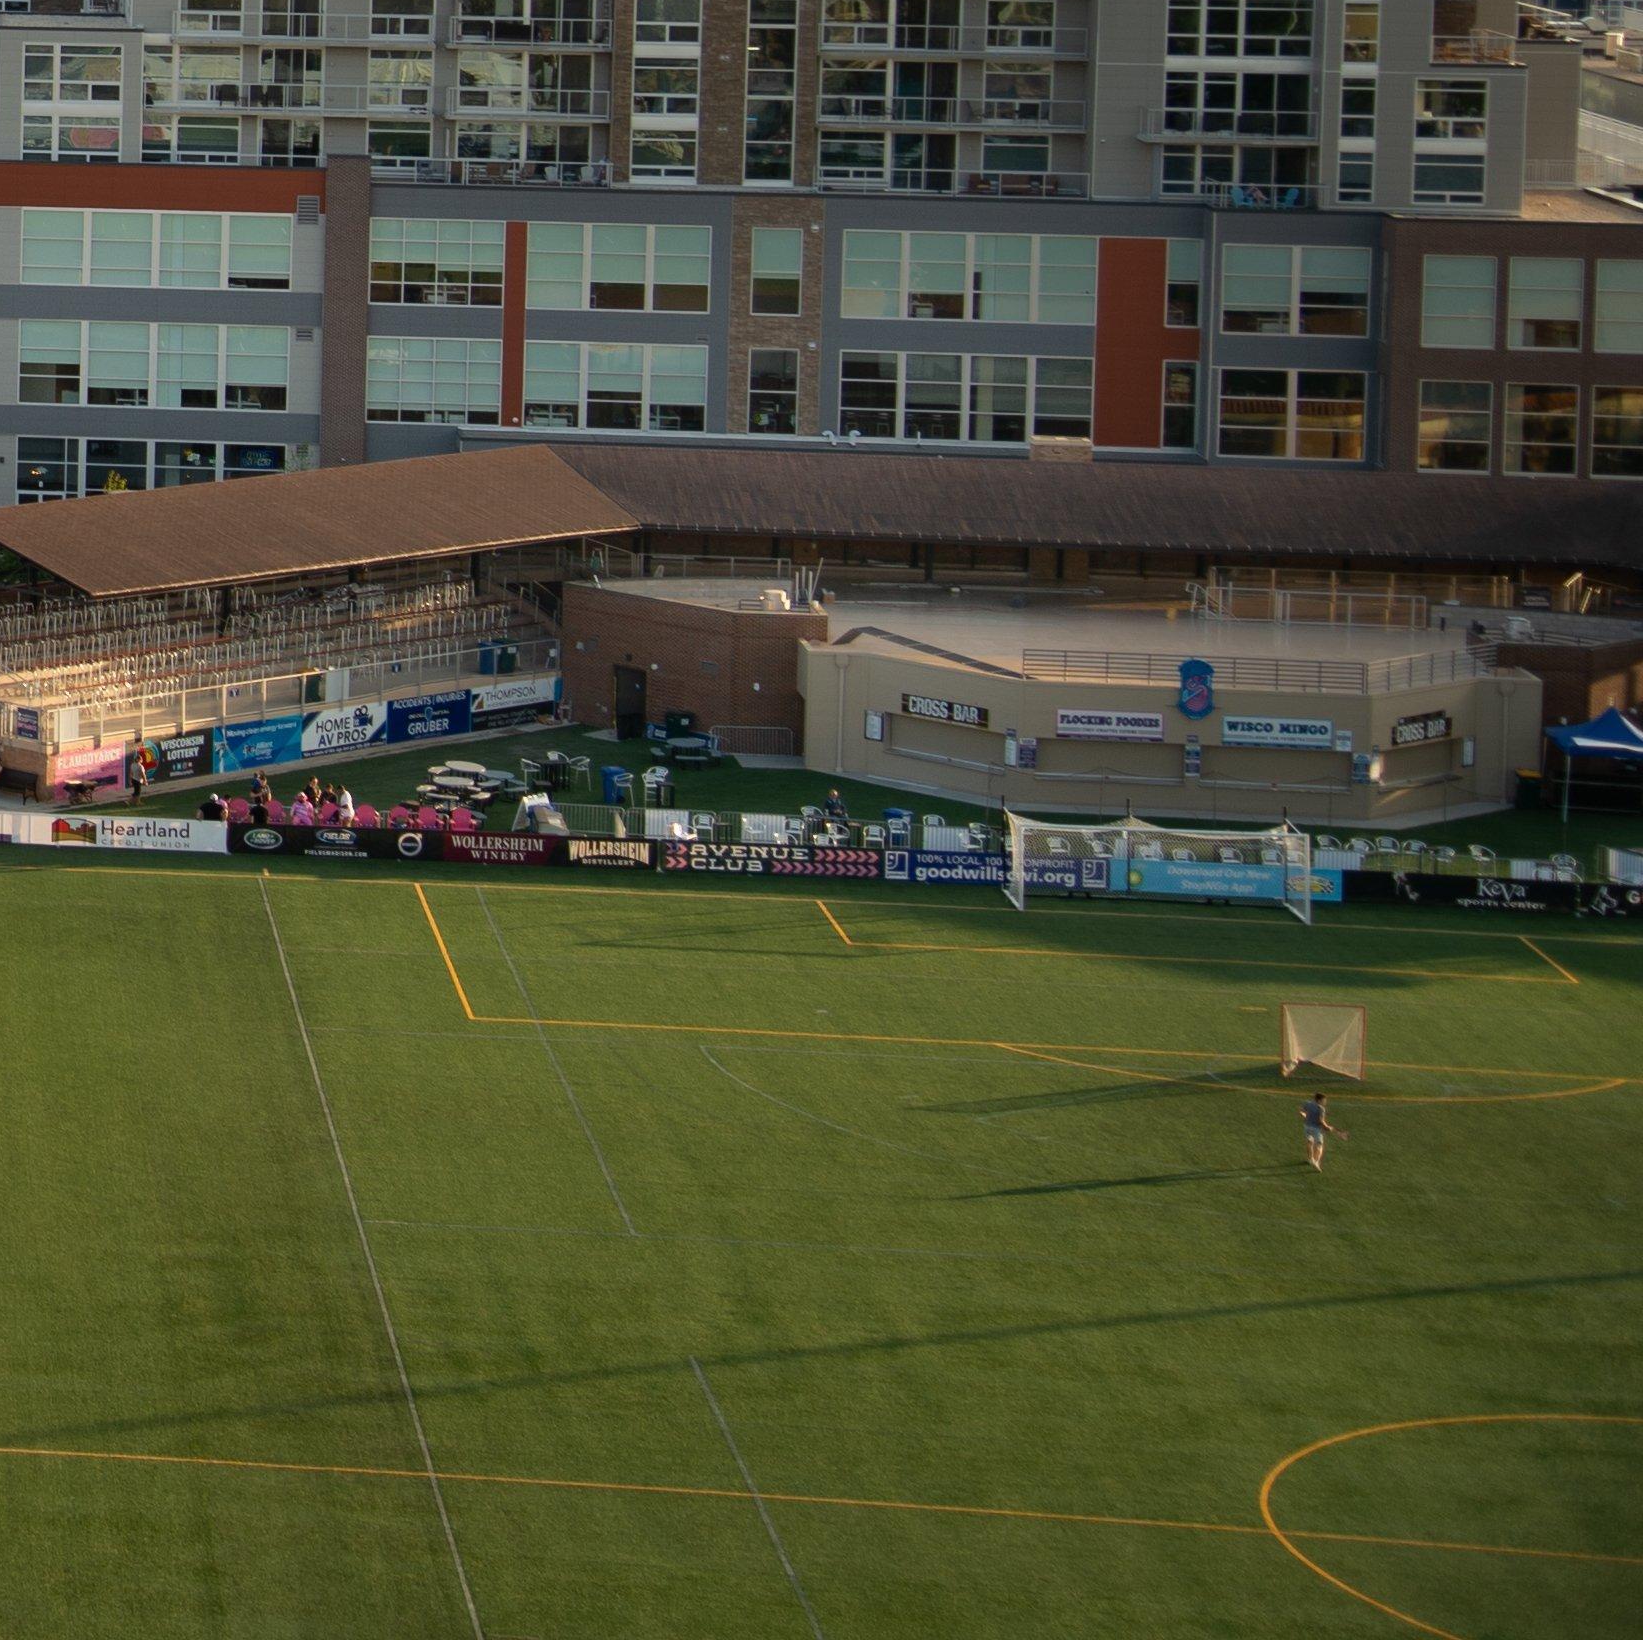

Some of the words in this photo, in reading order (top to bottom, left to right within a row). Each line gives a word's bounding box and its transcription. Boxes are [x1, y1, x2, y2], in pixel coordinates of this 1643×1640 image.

[485, 686, 537, 701] THOMPSON
[909, 695, 948, 719] CROSS
[953, 704, 978, 724] BAR
[315, 716, 351, 734] HOME
[407, 717, 450, 736] GRUBER
[1059, 714, 1112, 726] FLOCKING
[1116, 717, 1160, 728] FOODIES
[1226, 721, 1274, 733] WISCO
[1279, 723, 1329, 736] MINGO
[318, 732, 334, 748] AV
[336, 728, 367, 743] PROS
[1396, 722, 1425, 743] CROSS
[1427, 719, 1447, 738] BAR
[160, 735, 204, 751] WISCONSIN
[167, 746, 199, 761] LOTTERY
[101, 820, 190, 839] Heartland
[323, 832, 350, 840] FIELDS
[451, 835, 544, 851] WOLLERSHEIM
[470, 850, 526, 861] WINERY
[568, 840, 650, 864] WOLLERSHEIM
[690, 844, 809, 859] AVENUE
[582, 858, 635, 866] DISTILLERY
[691, 858, 763, 872] CLUB
[916, 854, 943, 864] 100%
[1016, 858, 1077, 869] ONPROFIT.
[1167, 865, 1222, 877] Download
[1225, 868, 1245, 878] Our
[1457, 898, 1499, 907] sports
[1502, 900, 1547, 909] center
